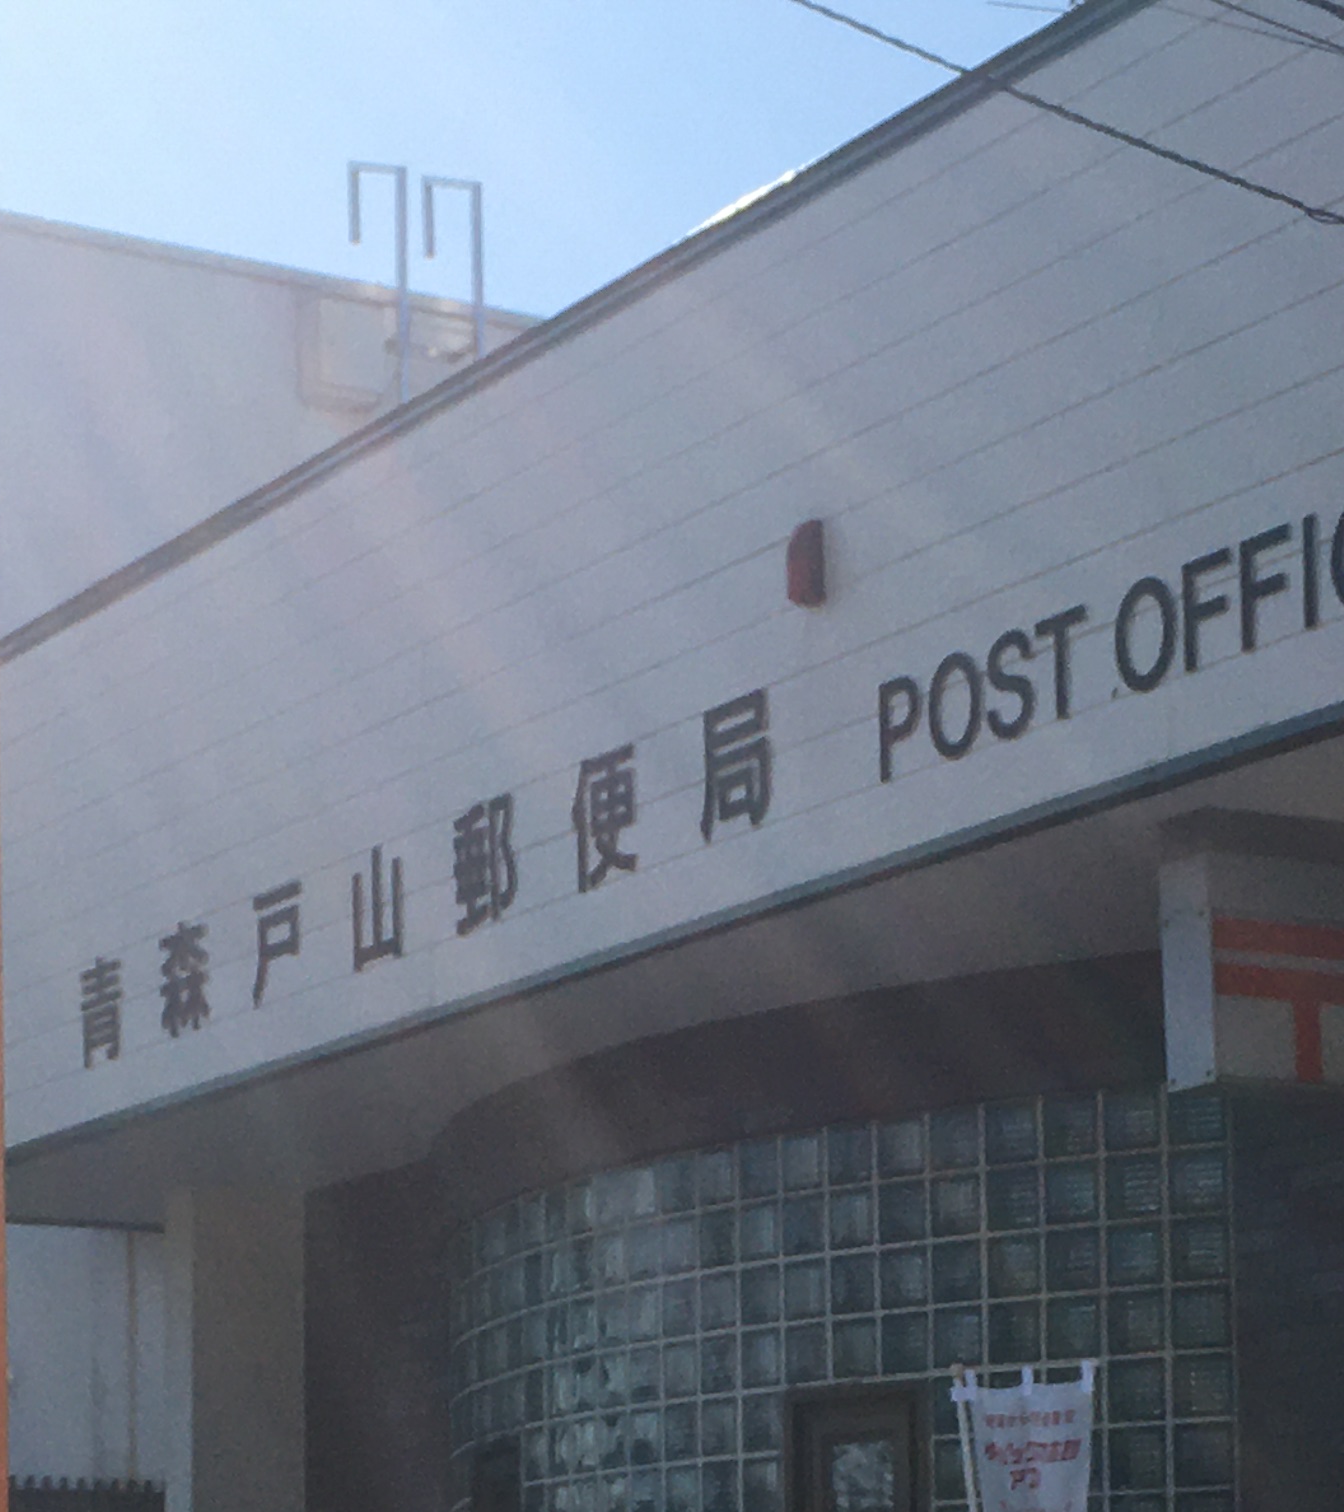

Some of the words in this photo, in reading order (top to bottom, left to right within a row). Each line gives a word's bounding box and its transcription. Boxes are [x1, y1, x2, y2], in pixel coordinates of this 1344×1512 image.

[877, 604, 1088, 784] POST
[79, 687, 776, 1069] 青森戸山郵便局
